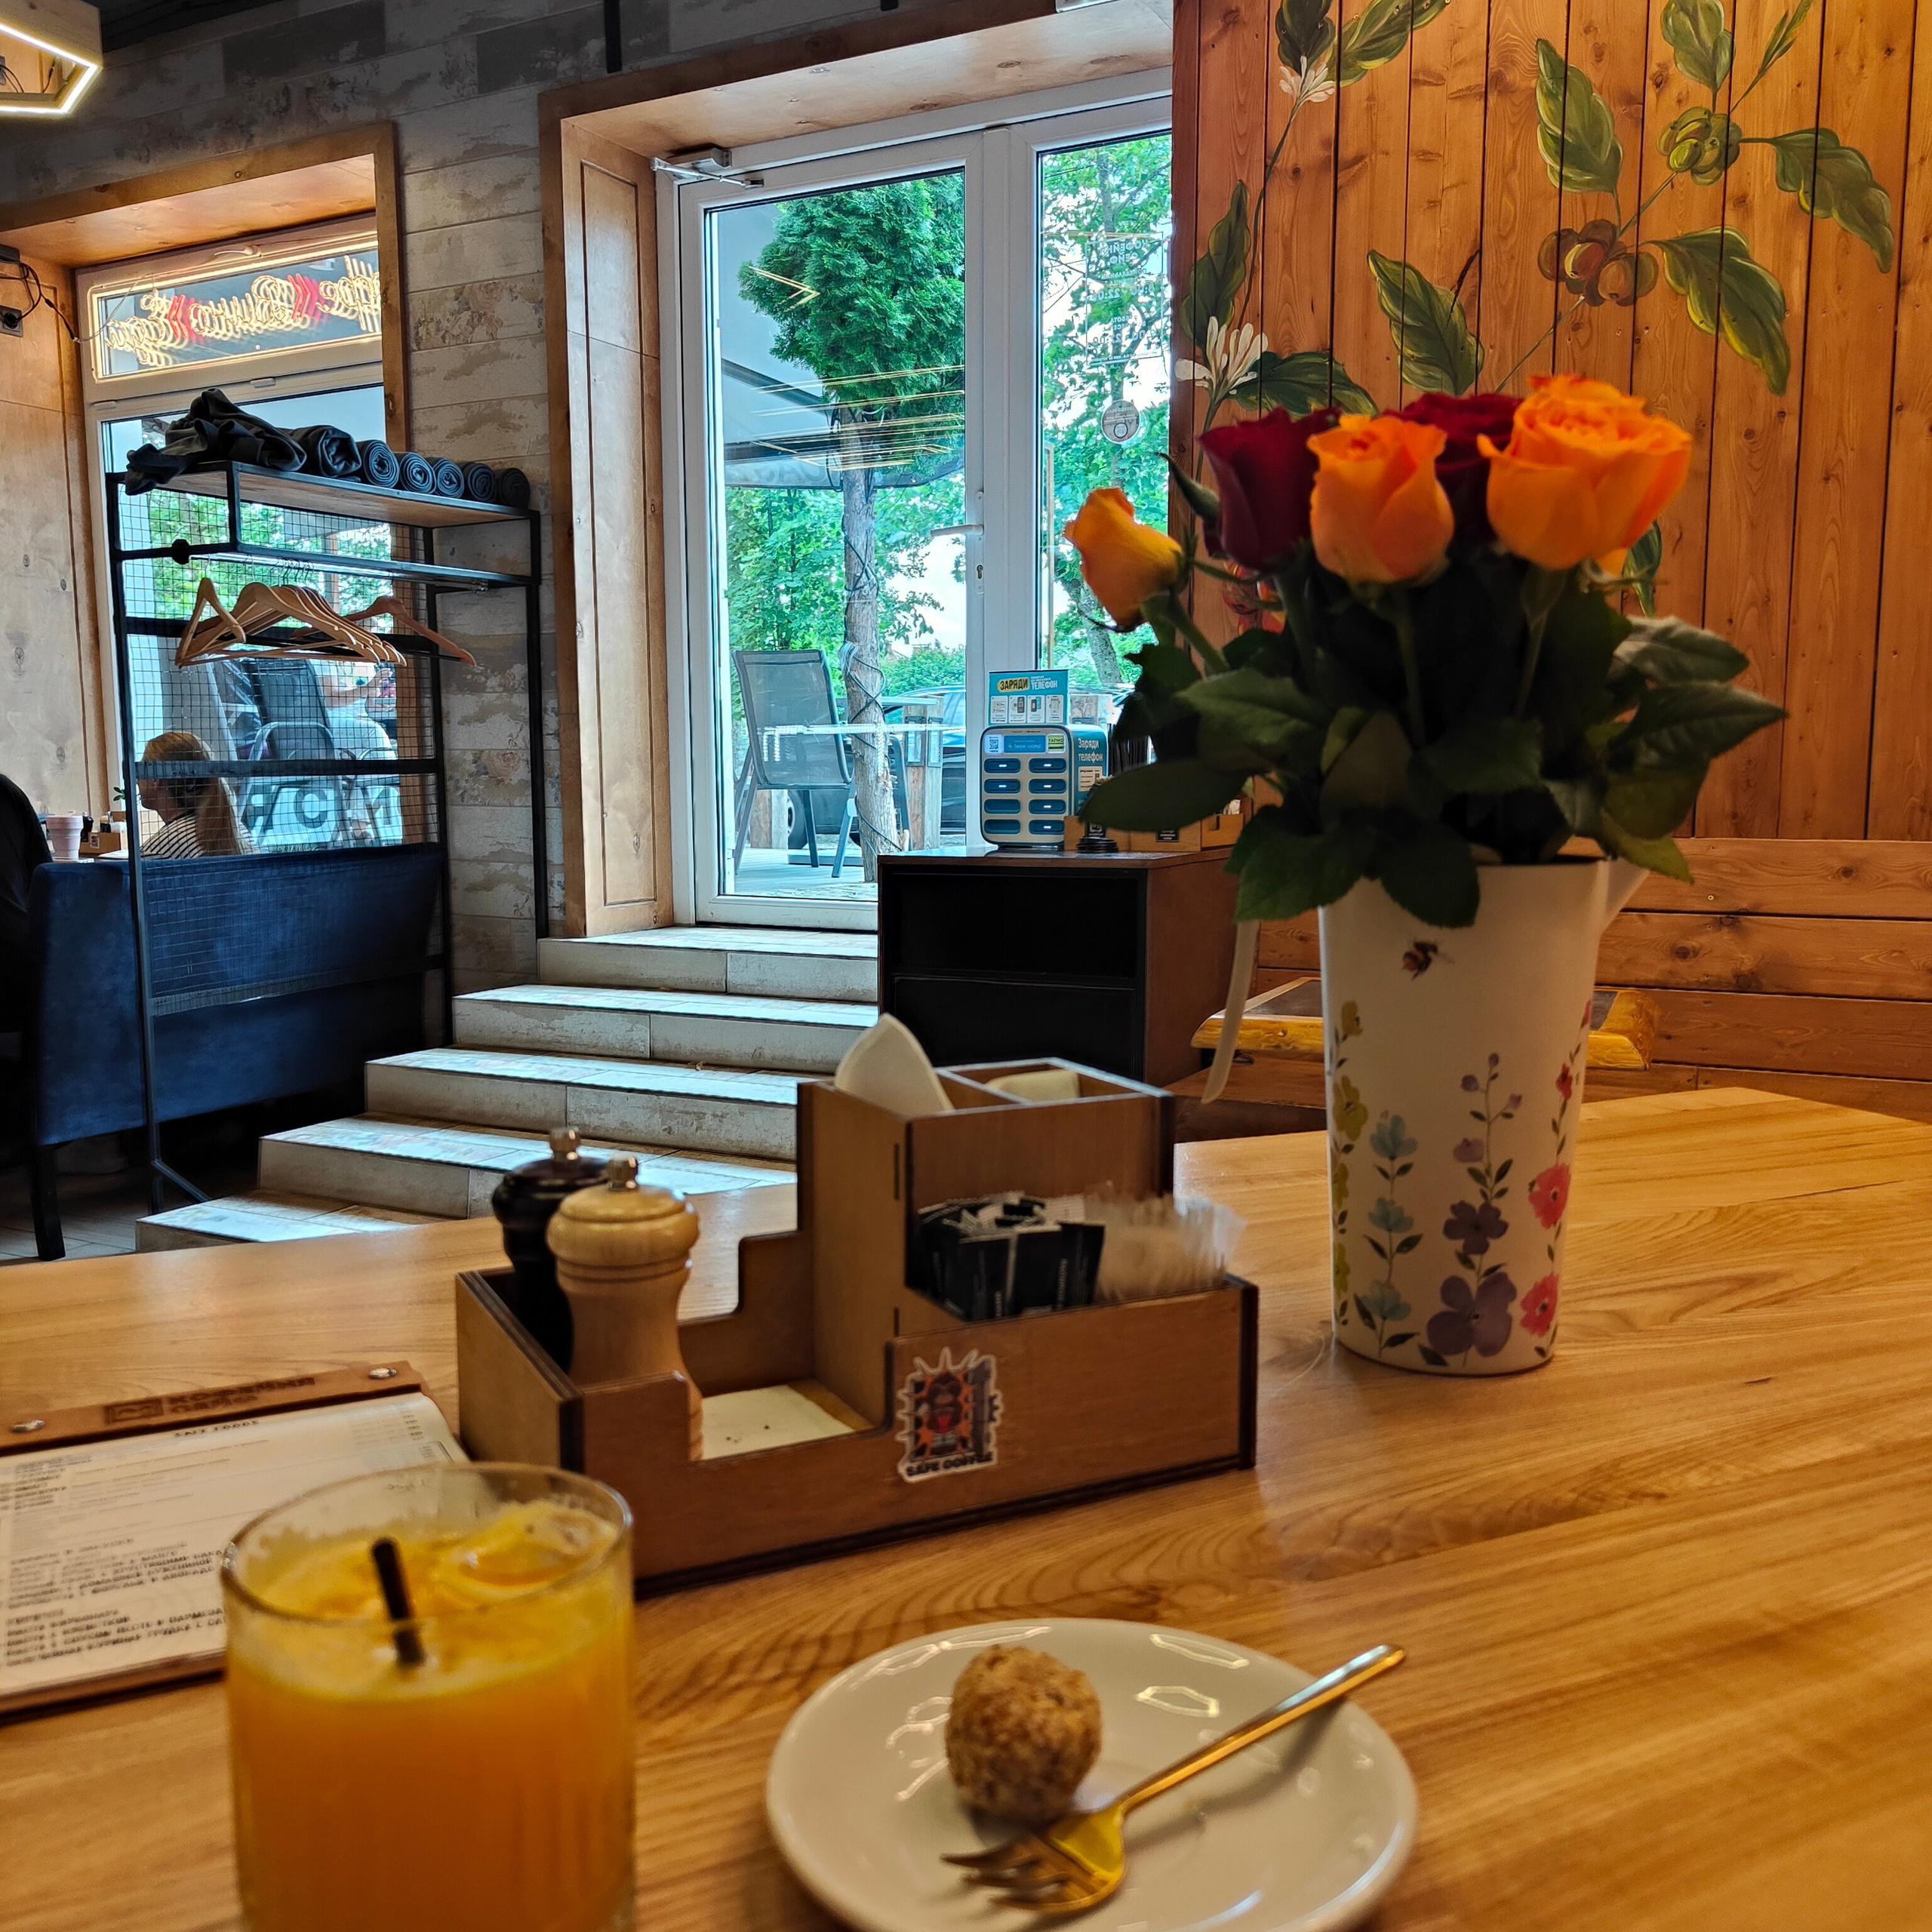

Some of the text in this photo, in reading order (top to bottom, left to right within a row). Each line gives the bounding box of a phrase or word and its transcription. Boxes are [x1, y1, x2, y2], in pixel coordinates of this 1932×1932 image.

[1000, 678, 1028, 690] ЗАРЯДИ
[1031, 680, 1057, 690] ТЕЛЕФОН
[1078, 737, 1100, 749] Заряди
[1078, 752, 1103, 764] телефон
